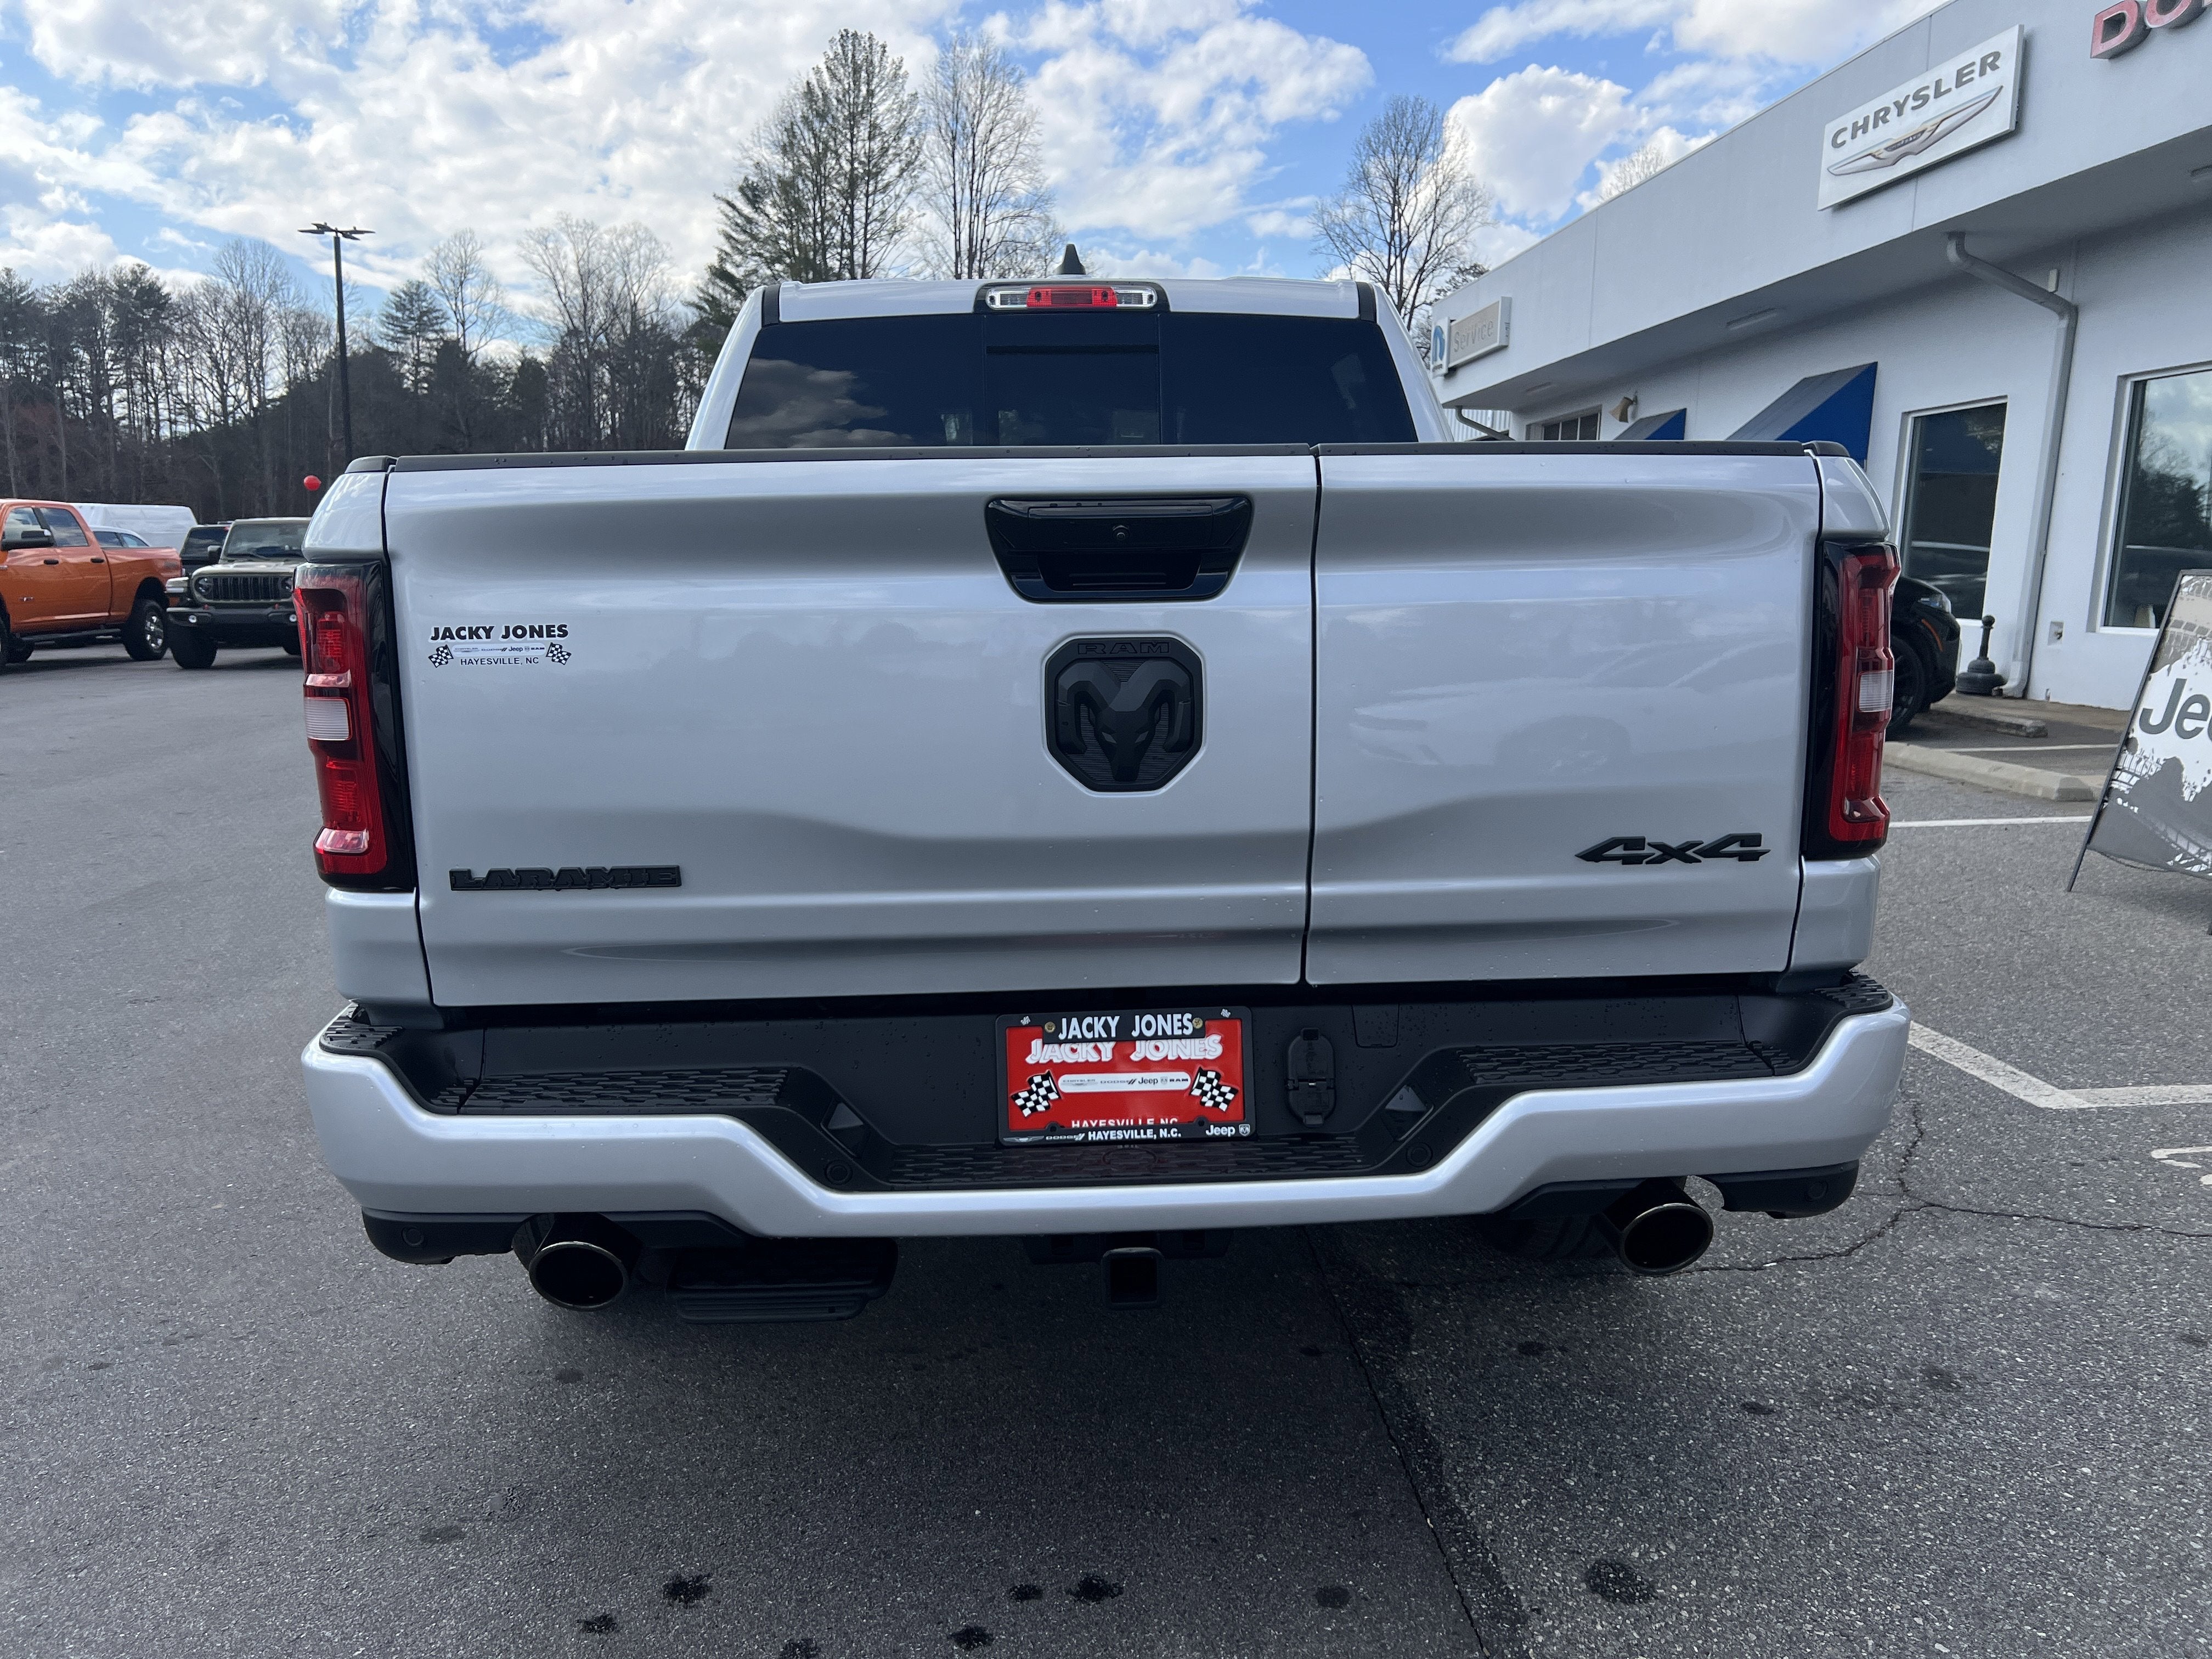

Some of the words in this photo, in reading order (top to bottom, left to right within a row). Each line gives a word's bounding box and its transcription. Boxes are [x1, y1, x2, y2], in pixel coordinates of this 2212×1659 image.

[2090, 0, 2212, 59] DO
[1831, 50, 2002, 149] CHRYSLER
[1453, 320, 1494, 353] Service
[430, 625, 495, 641] JACKY
[500, 624, 569, 639] JONES
[1077, 641, 1170, 655] RAM
[2138, 678, 2212, 740] Je
[449, 865, 682, 891] LARAMIE
[1058, 1015, 1120, 1040] JACKY
[1131, 1013, 1193, 1038] JONES
[1025, 1039, 1116, 1064] JACKY
[1130, 1034, 1224, 1062] JONES
[1138, 1077, 1159, 1085] Jeep
[1088, 1128, 1157, 1141] HAYESVILLE,
[1159, 1128, 1181, 1138] N.C.
[1205, 1124, 1236, 1137] Jeep
